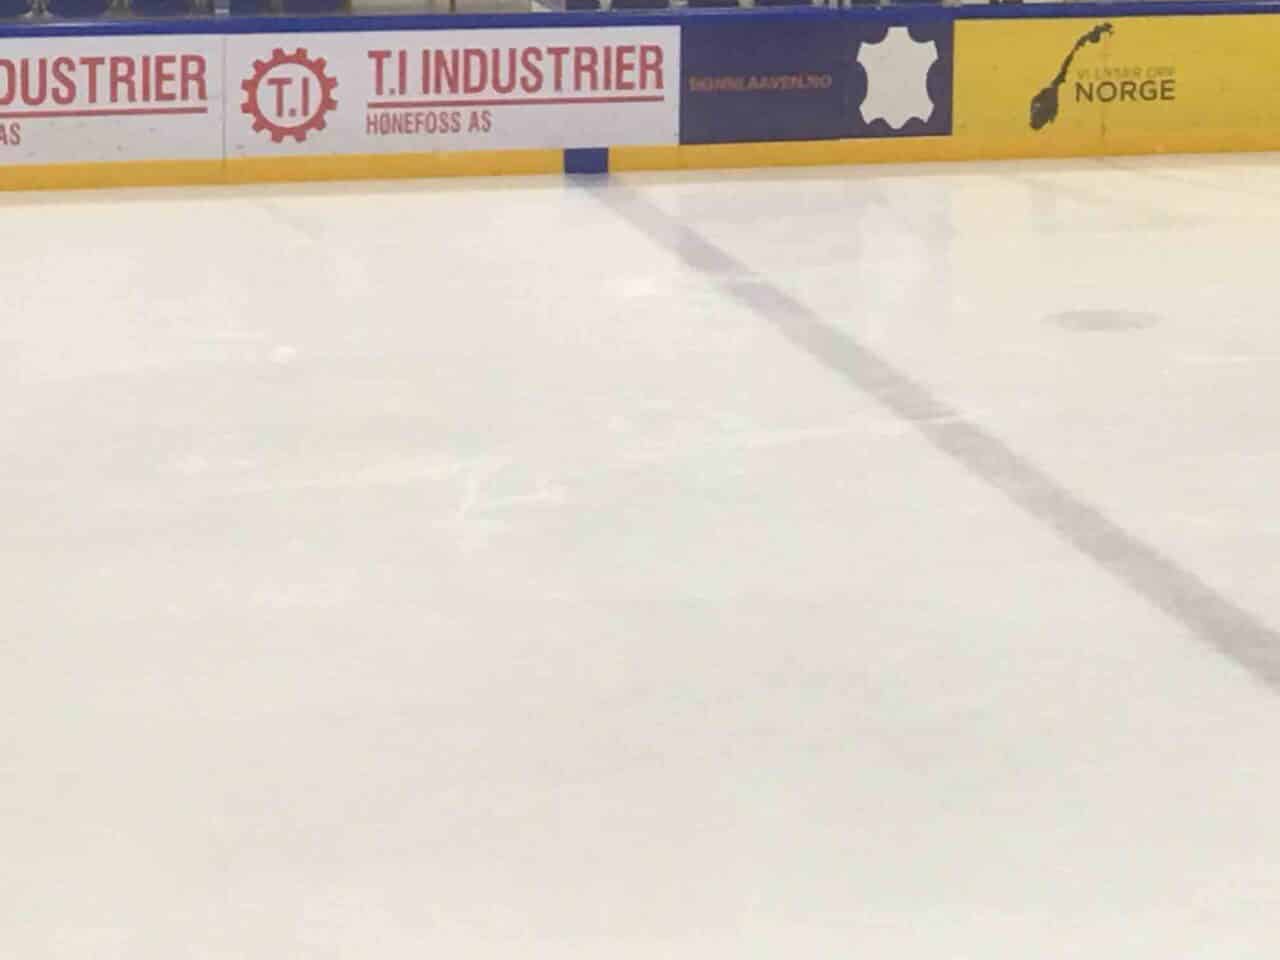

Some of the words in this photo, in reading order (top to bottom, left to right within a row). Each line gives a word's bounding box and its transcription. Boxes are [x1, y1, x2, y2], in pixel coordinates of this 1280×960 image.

[0, 54, 208, 106] DUSTRIER
[368, 49, 407, 96] T.I
[422, 44, 665, 95] INDUSTRIER
[266, 76, 309, 117] T.I
[1075, 79, 1176, 103] NORGE
[366, 111, 461, 135] HØNEFOSS
[468, 110, 492, 133] AS
